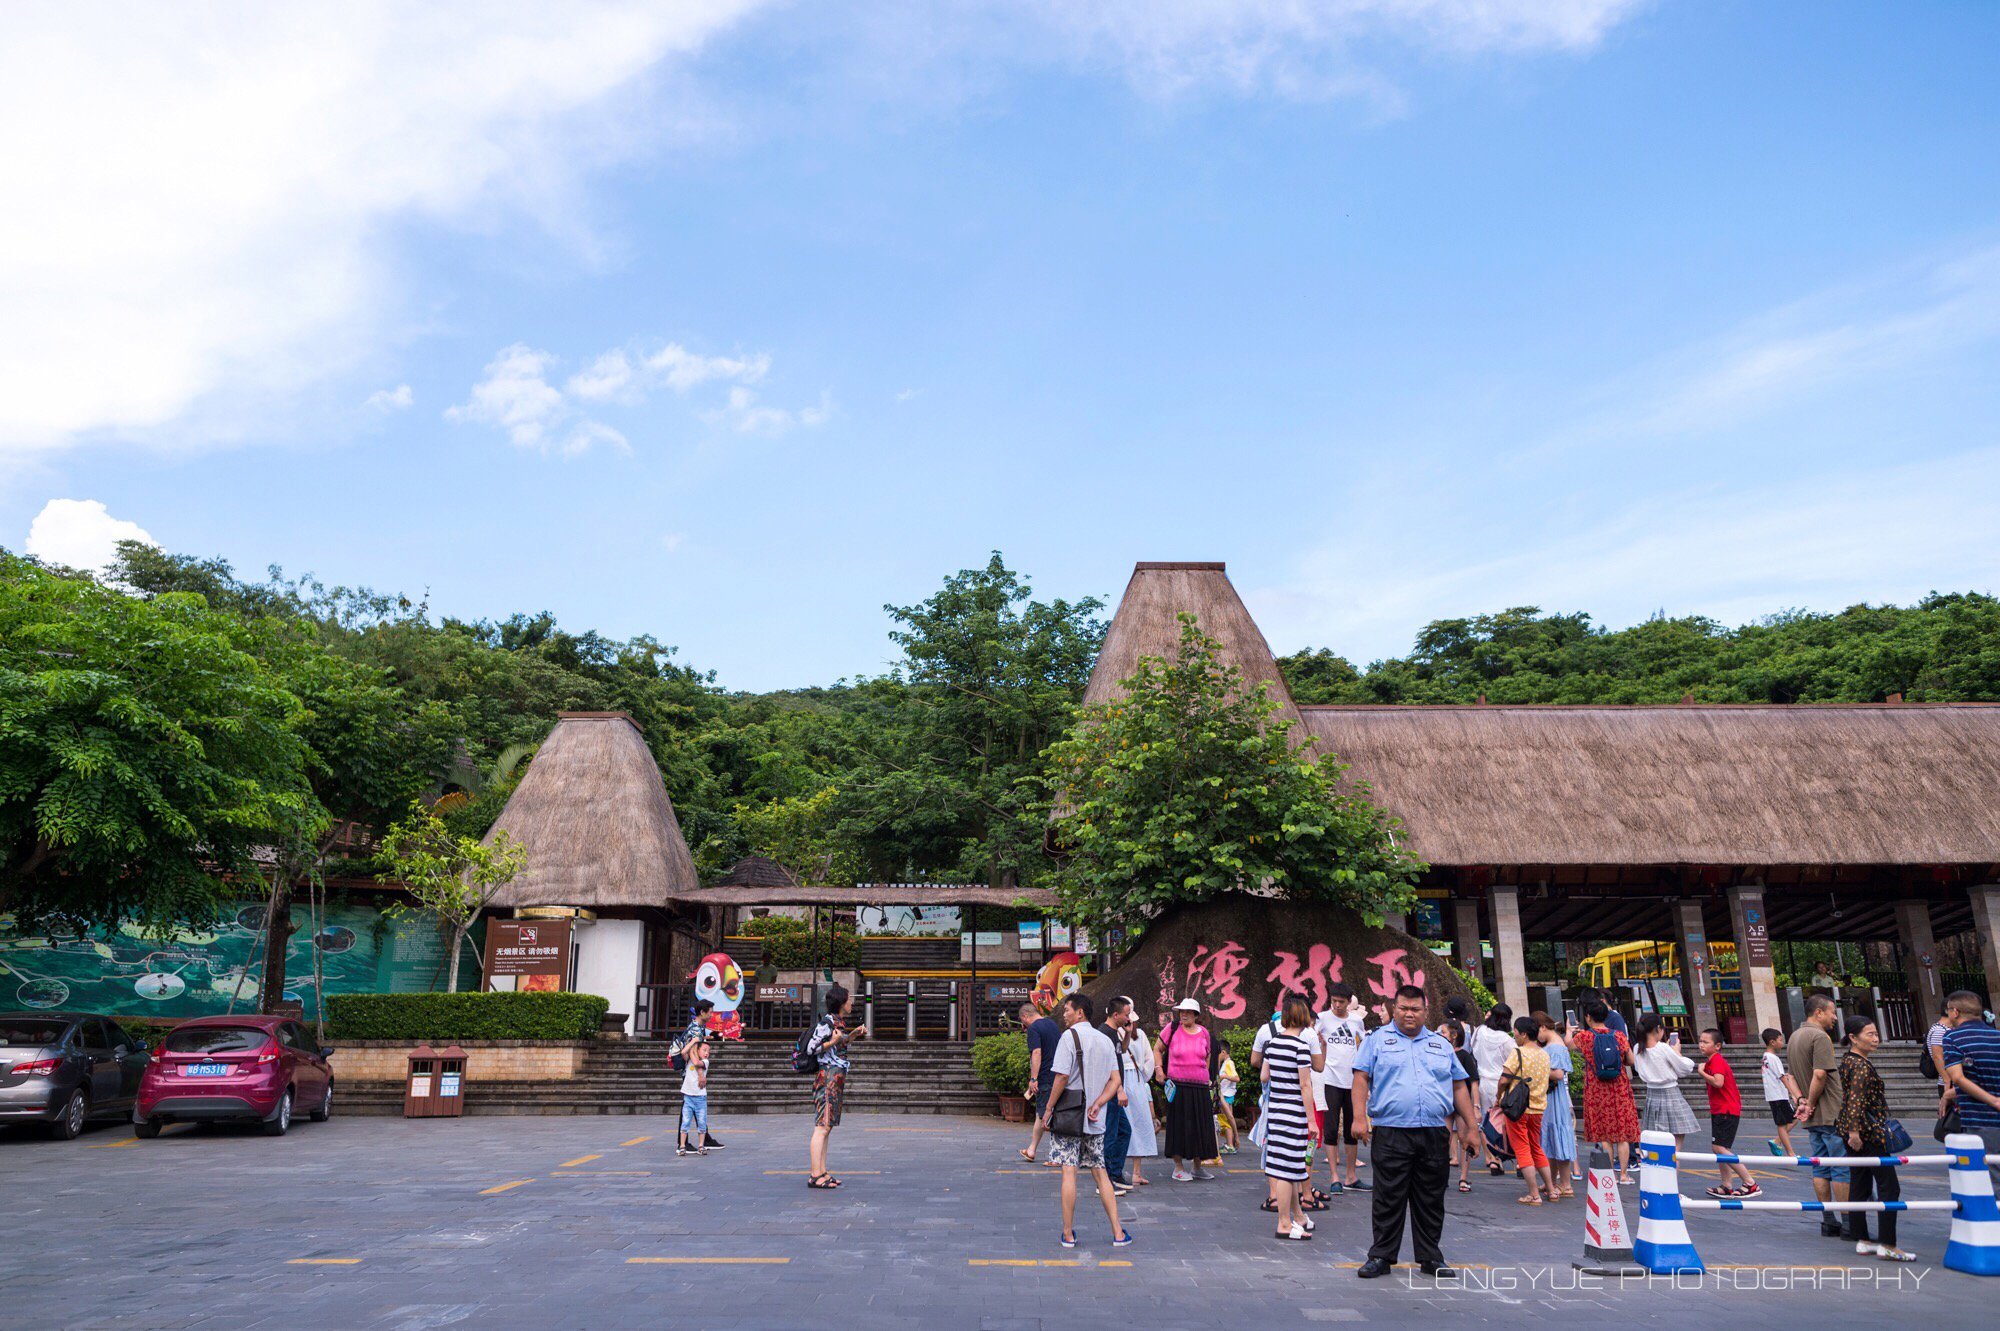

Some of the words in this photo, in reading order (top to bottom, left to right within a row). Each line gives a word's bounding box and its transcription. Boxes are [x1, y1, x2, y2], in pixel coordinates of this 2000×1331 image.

[496, 947, 526, 956] 无烟景区
[528, 946, 559, 955] 请勿吸烟
[1328, 1037, 1355, 1046] adidas
[1604, 1192, 1621, 1245] 禁止停车
